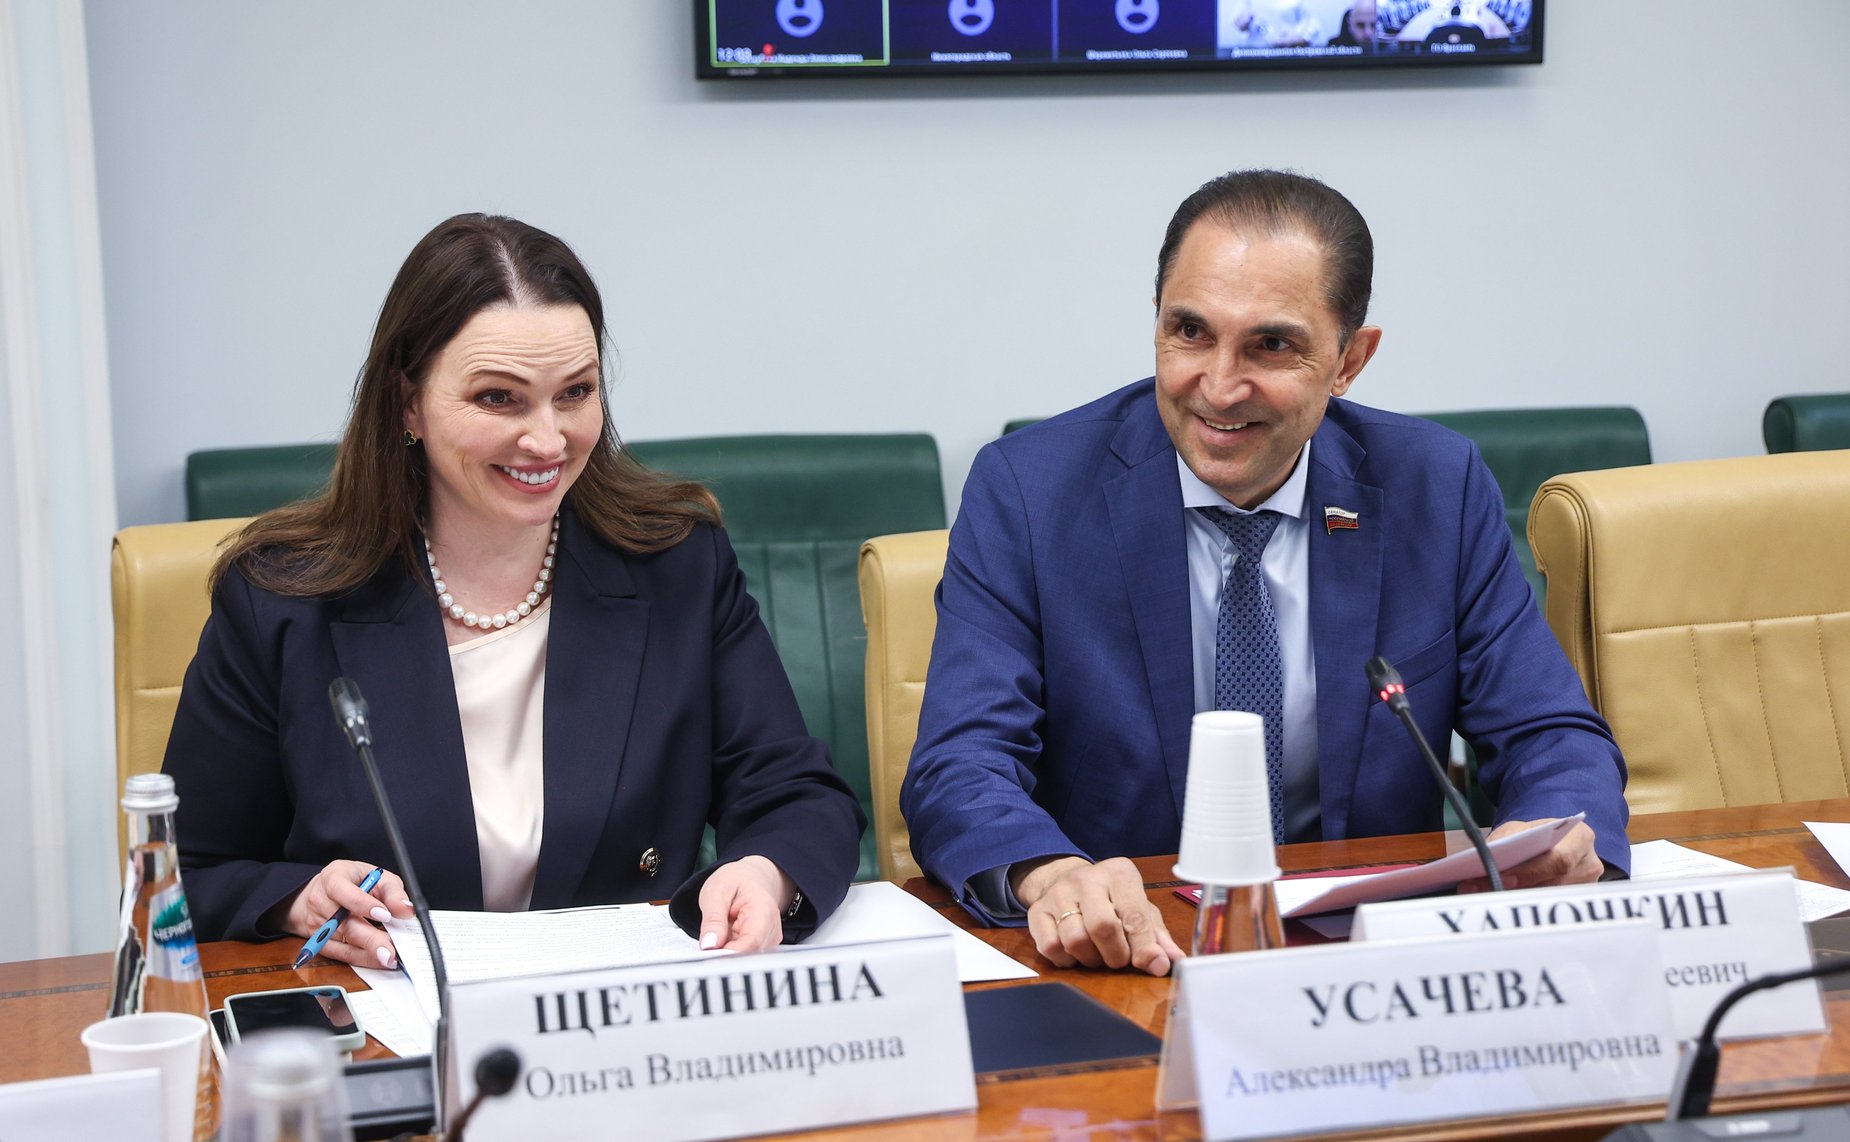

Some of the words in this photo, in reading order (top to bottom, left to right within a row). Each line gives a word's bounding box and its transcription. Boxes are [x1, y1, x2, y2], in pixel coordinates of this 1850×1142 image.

[533, 960, 884, 1038] ЩЕТИНИНА
[1301, 966, 1567, 1028] УСАЧЕВА
[525, 1066, 634, 1101] Ольга
[645, 1034, 906, 1087] Владимировна
[1226, 1057, 1412, 1098] Александра
[1417, 1032, 1663, 1082] Владимировна
